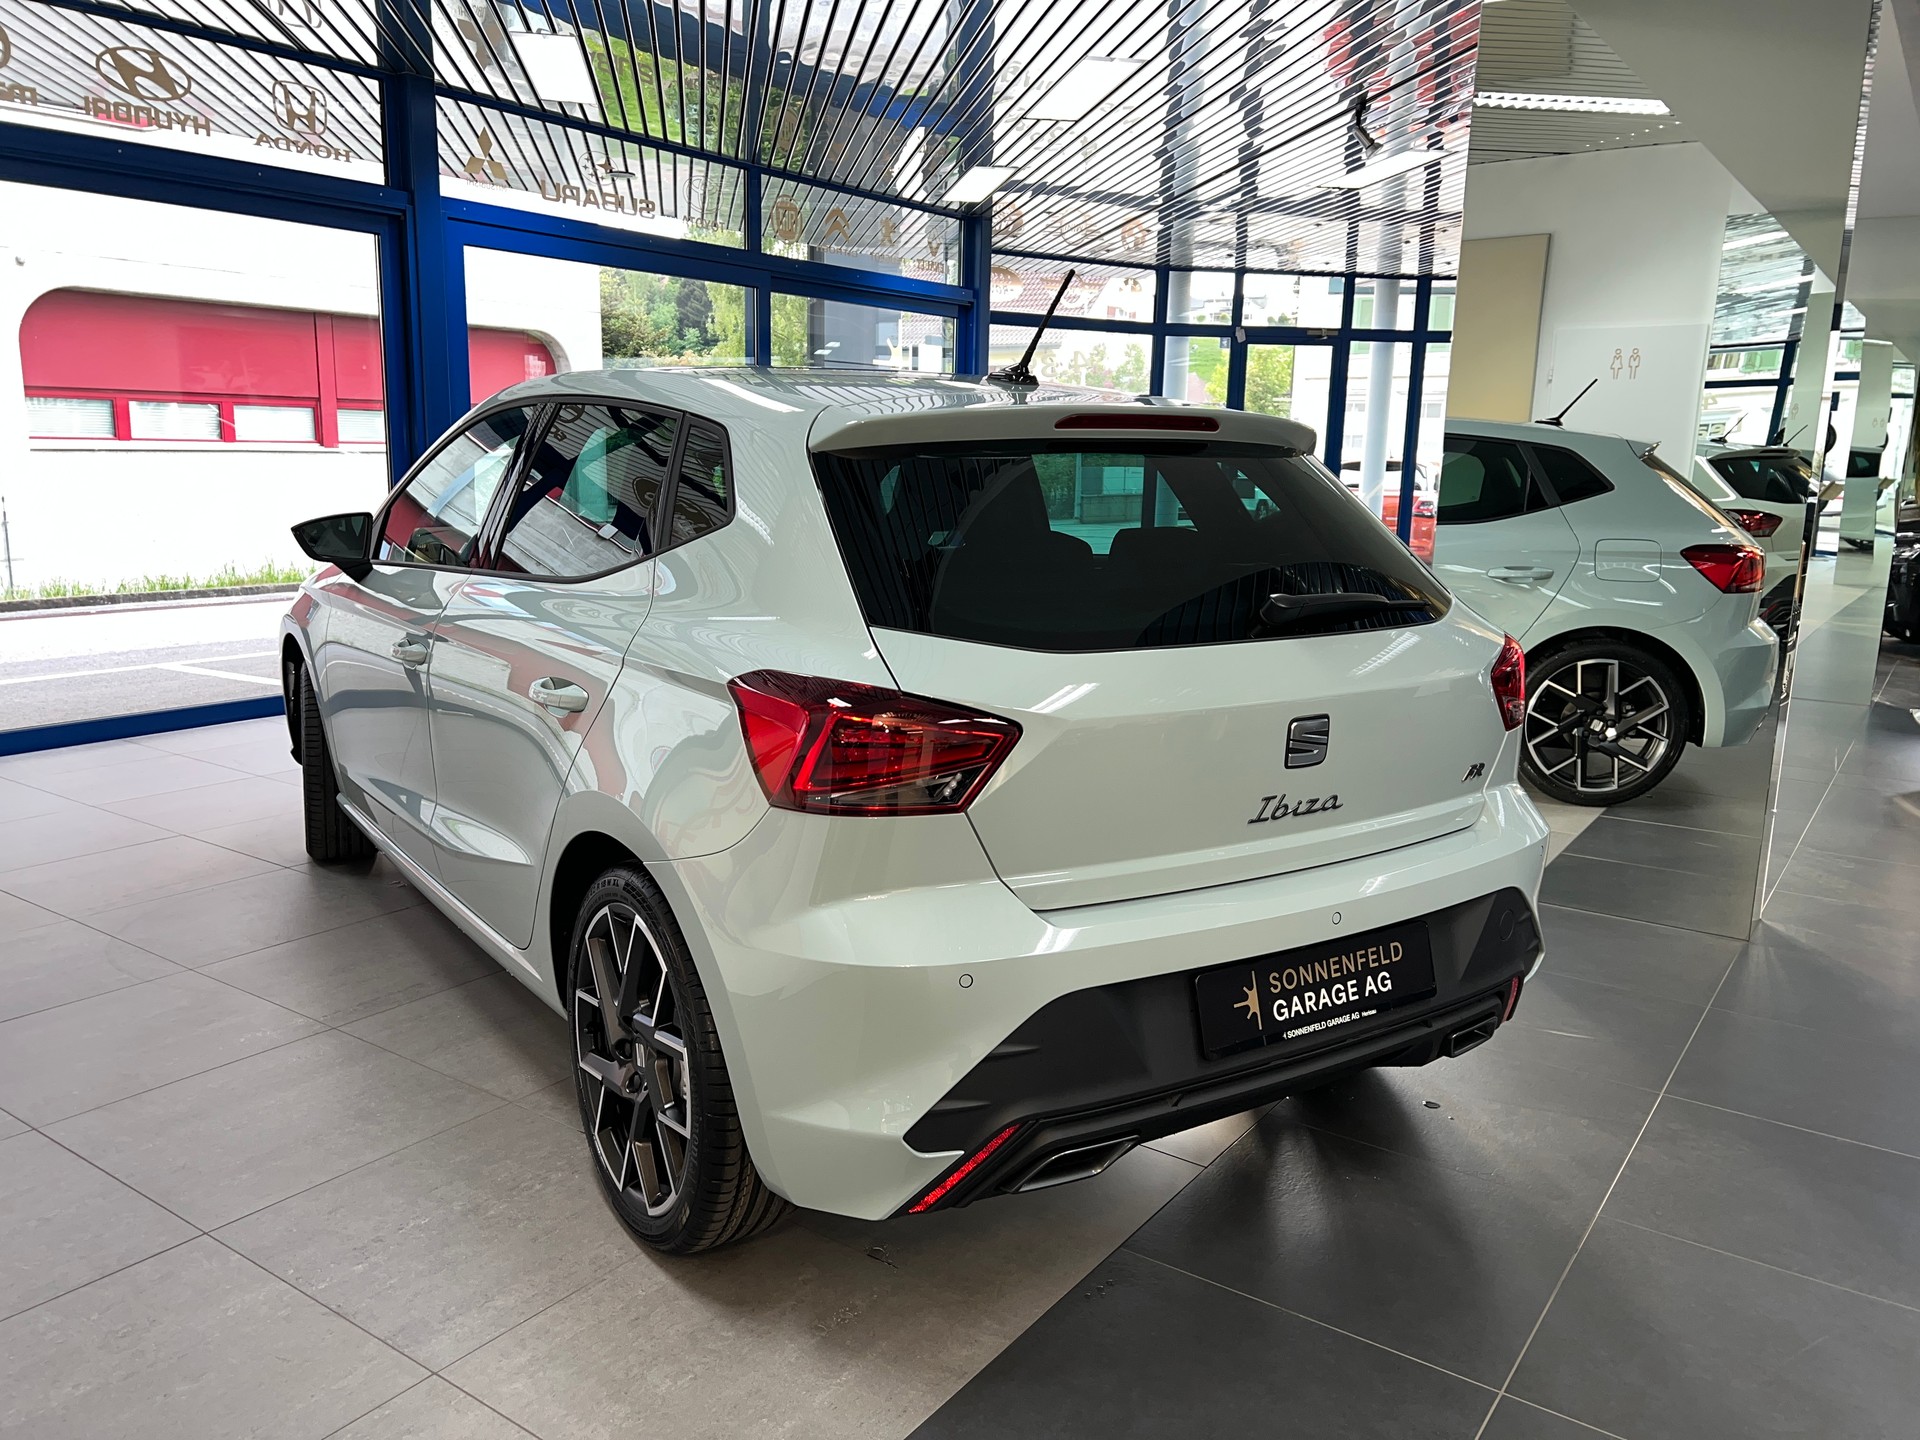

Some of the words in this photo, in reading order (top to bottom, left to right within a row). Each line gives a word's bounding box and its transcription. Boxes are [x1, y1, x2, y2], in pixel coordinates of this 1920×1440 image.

[1247, 793, 1343, 824] Ibiza
[1269, 941, 1403, 993] SONNENFELD
[1273, 979, 1359, 1021] GARAGE
[1365, 971, 1392, 997] AG
[1287, 1021, 1327, 1039] SONNENFELD
[1326, 1014, 1351, 1028] GARAGE
[1351, 1011, 1360, 1021] AG
